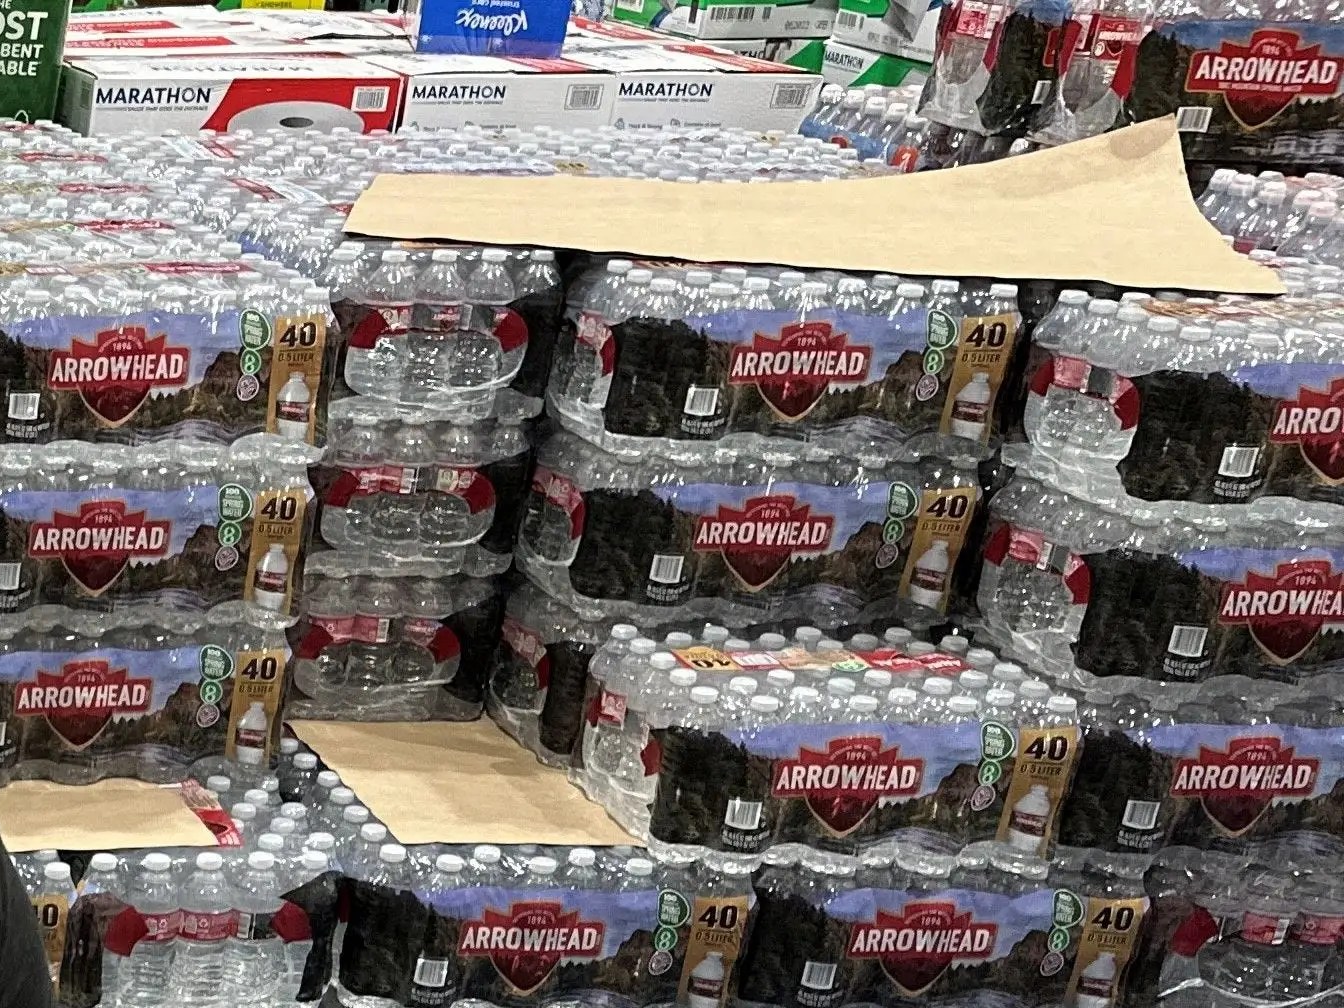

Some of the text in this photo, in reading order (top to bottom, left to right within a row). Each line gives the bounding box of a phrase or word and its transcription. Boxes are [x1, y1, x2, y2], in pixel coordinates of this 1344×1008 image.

[455, 8, 528, 37] Kleenex
[824, 52, 864, 69] MARATHON
[1194, 54, 1338, 86] ARROWHEAD
[96, 87, 211, 105] MARATHON
[412, 86, 506, 101] MARATHON
[619, 83, 712, 99] MARATHON
[279, 321, 316, 347] 40
[965, 321, 1008, 348] 40
[51, 353, 185, 383] ARROWHEAD
[731, 350, 867, 377] ARROWHEAD
[260, 496, 297, 521] 40
[926, 495, 968, 520] 40
[32, 526, 166, 553] ARROWHEAD
[696, 521, 828, 546] ARROWHEAD
[1221, 589, 1344, 618] ARROWHEA
[241, 656, 277, 681] 40
[17, 683, 148, 710] ARROWHEAD
[1023, 736, 1068, 761] 40
[776, 763, 918, 793] ARROWHEAD
[1174, 764, 1312, 792] ARROWHEAD
[698, 905, 739, 930] 40
[1092, 907, 1135, 931] 40
[462, 926, 598, 954] ARROWHEAD
[852, 927, 990, 954] ARROWHEAD
